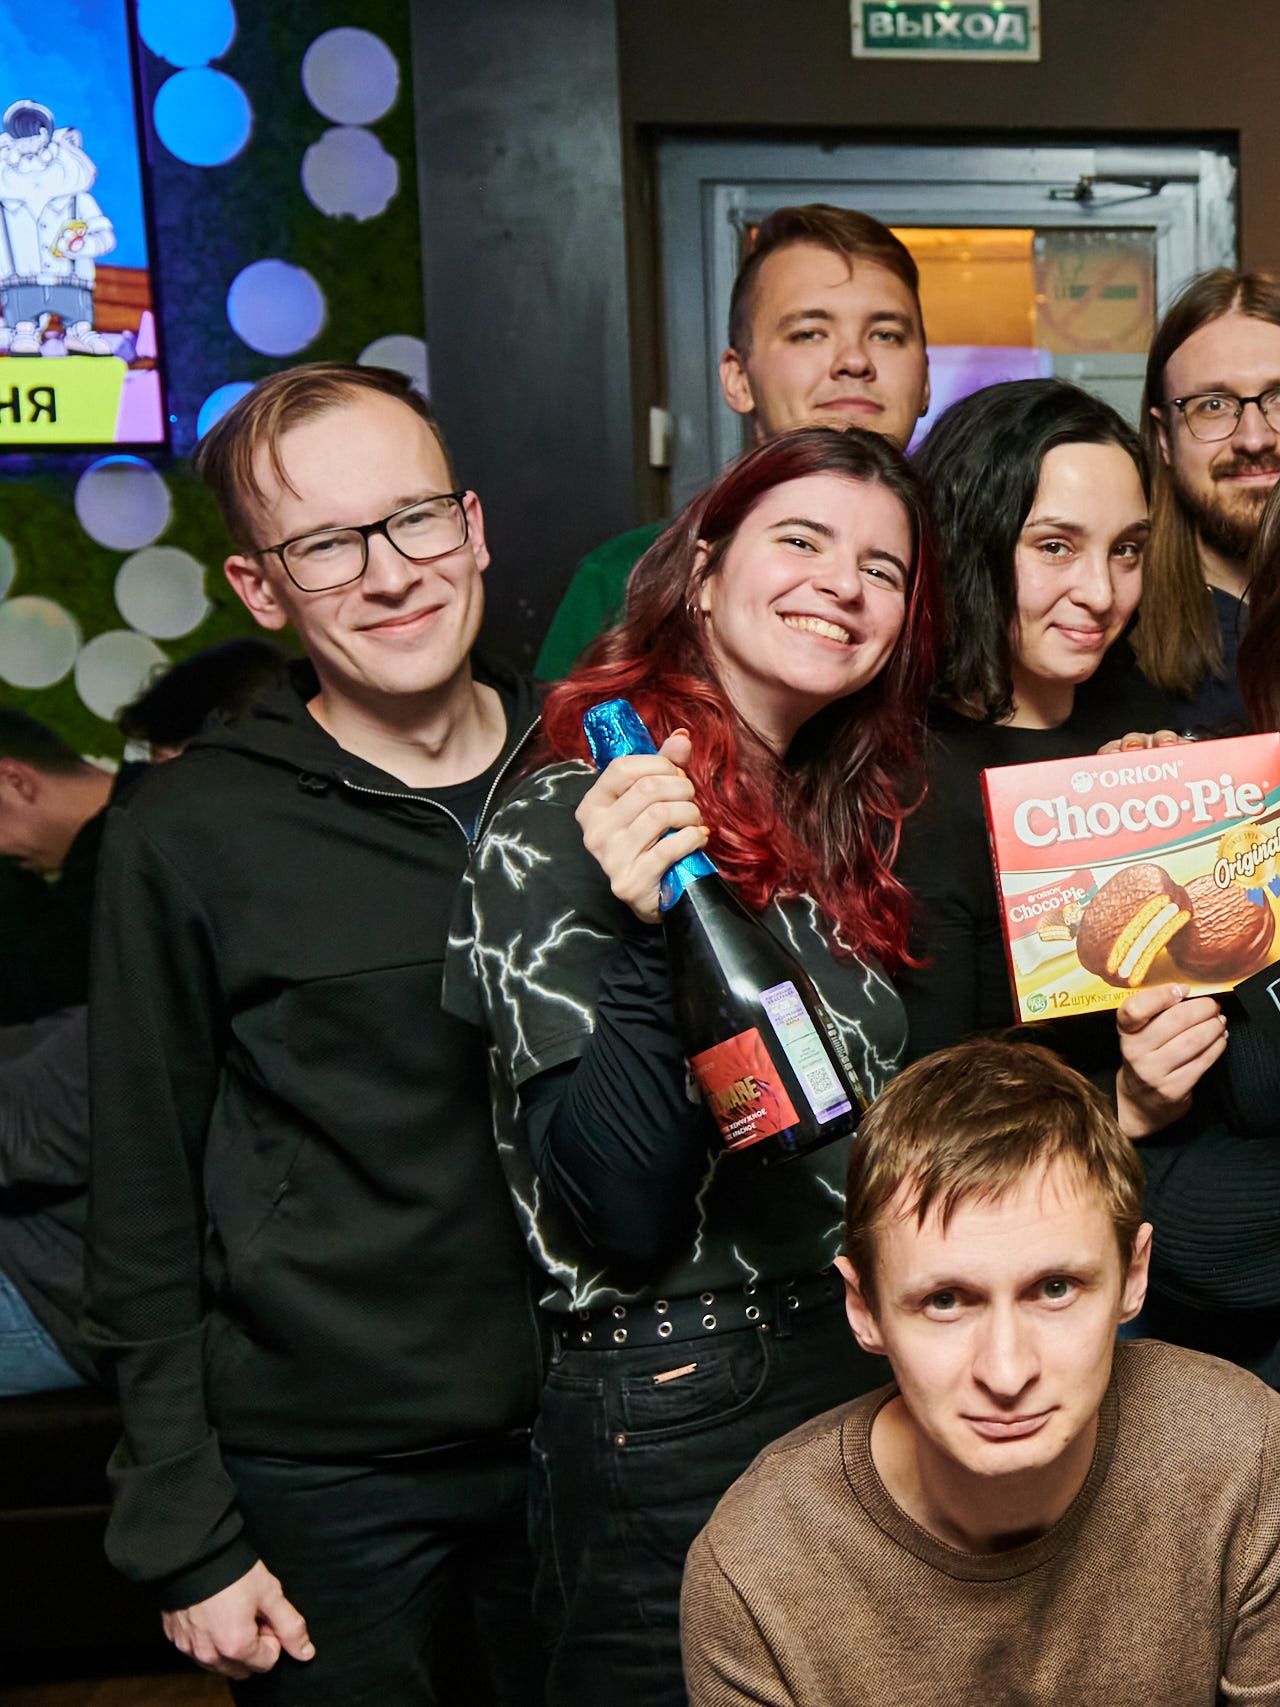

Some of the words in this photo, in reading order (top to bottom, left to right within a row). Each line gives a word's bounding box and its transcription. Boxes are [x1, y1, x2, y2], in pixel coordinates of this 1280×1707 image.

[868, 11, 1026, 44] ВЫХОД
[1099, 764, 1180, 788] ORION
[1049, 991, 1071, 1009] 12
